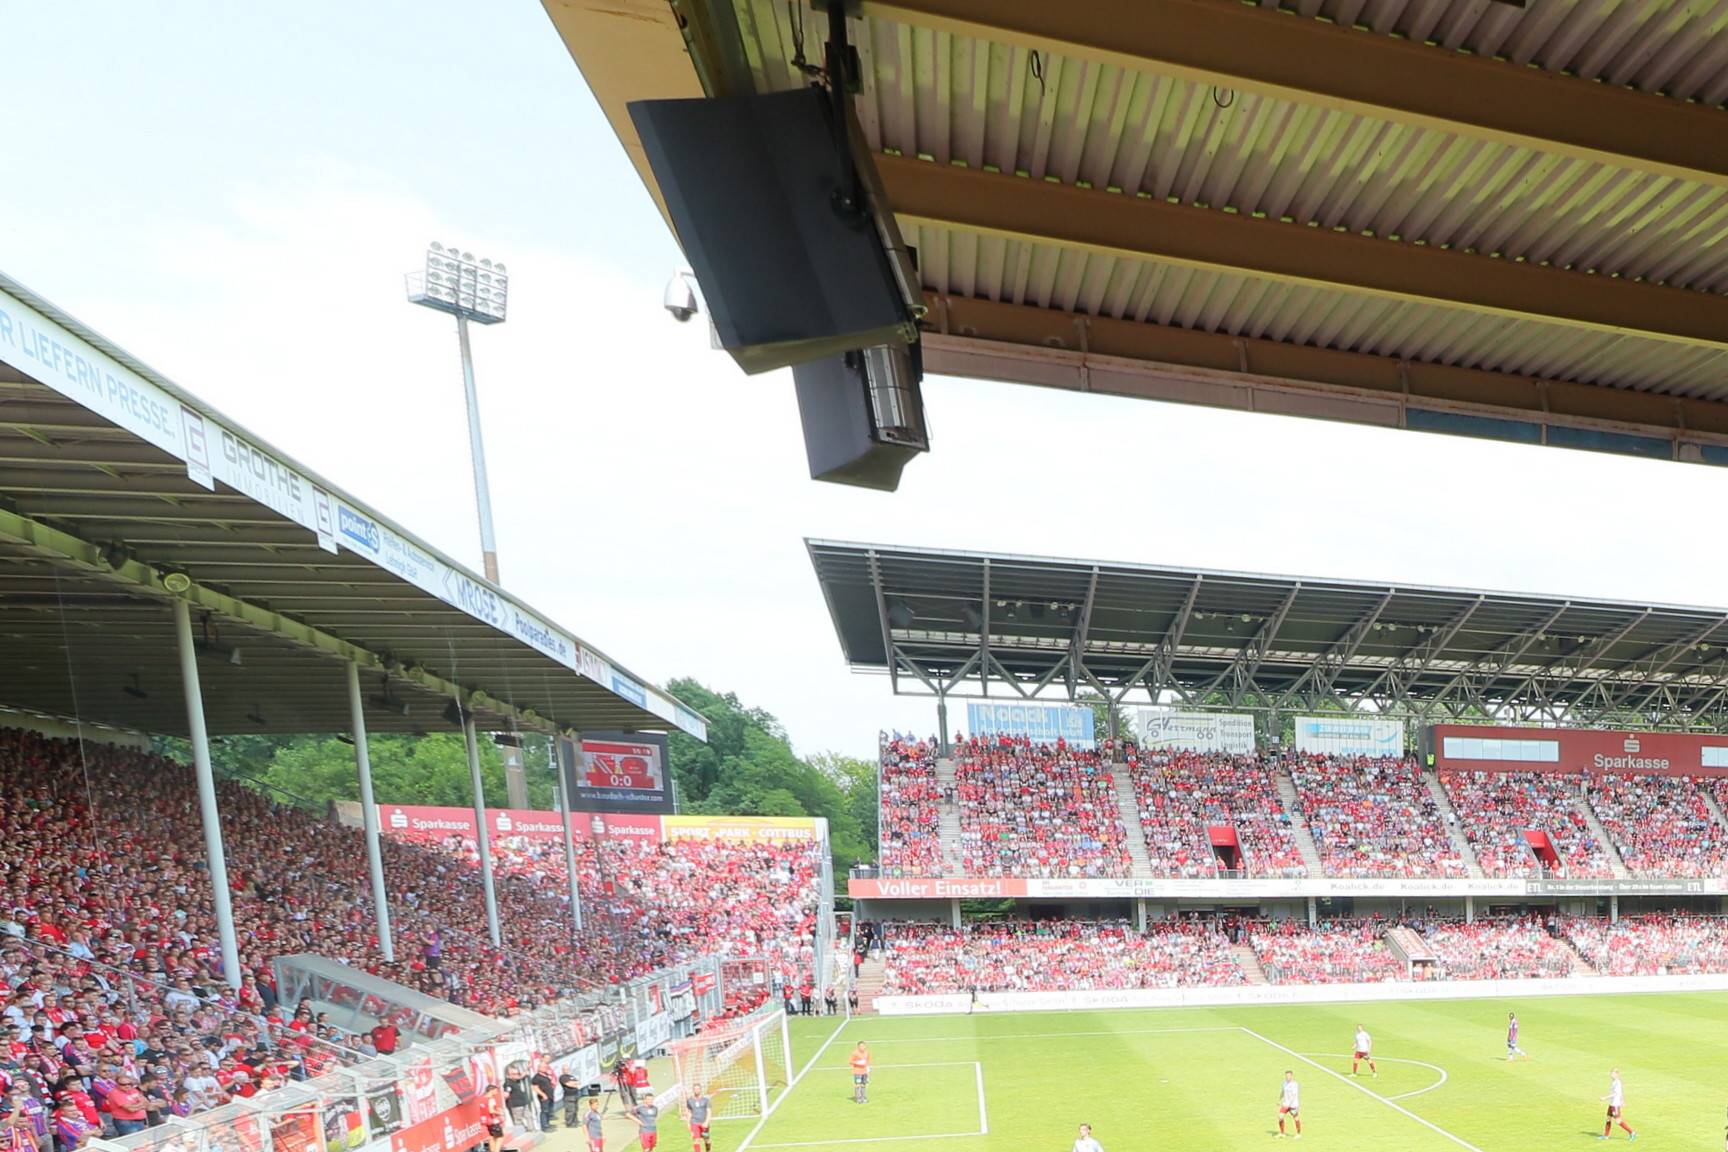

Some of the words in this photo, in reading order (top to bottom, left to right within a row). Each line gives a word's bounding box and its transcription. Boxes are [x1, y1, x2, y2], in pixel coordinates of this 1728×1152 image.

[20, 321, 104, 398] LIEFERN
[222, 430, 302, 502] GROTHE
[458, 577, 498, 621] MROSE
[1593, 753, 1669, 771] Sparkasse
[610, 774, 632, 787] 0:0
[413, 818, 471, 833] Sparkasse
[607, 823, 655, 837] Sparkasse
[878, 881, 929, 896] Voller
[935, 881, 1001, 896] Einsatz!
[1528, 882, 1542, 892] ETL
[1687, 881, 1702, 892] ETL
